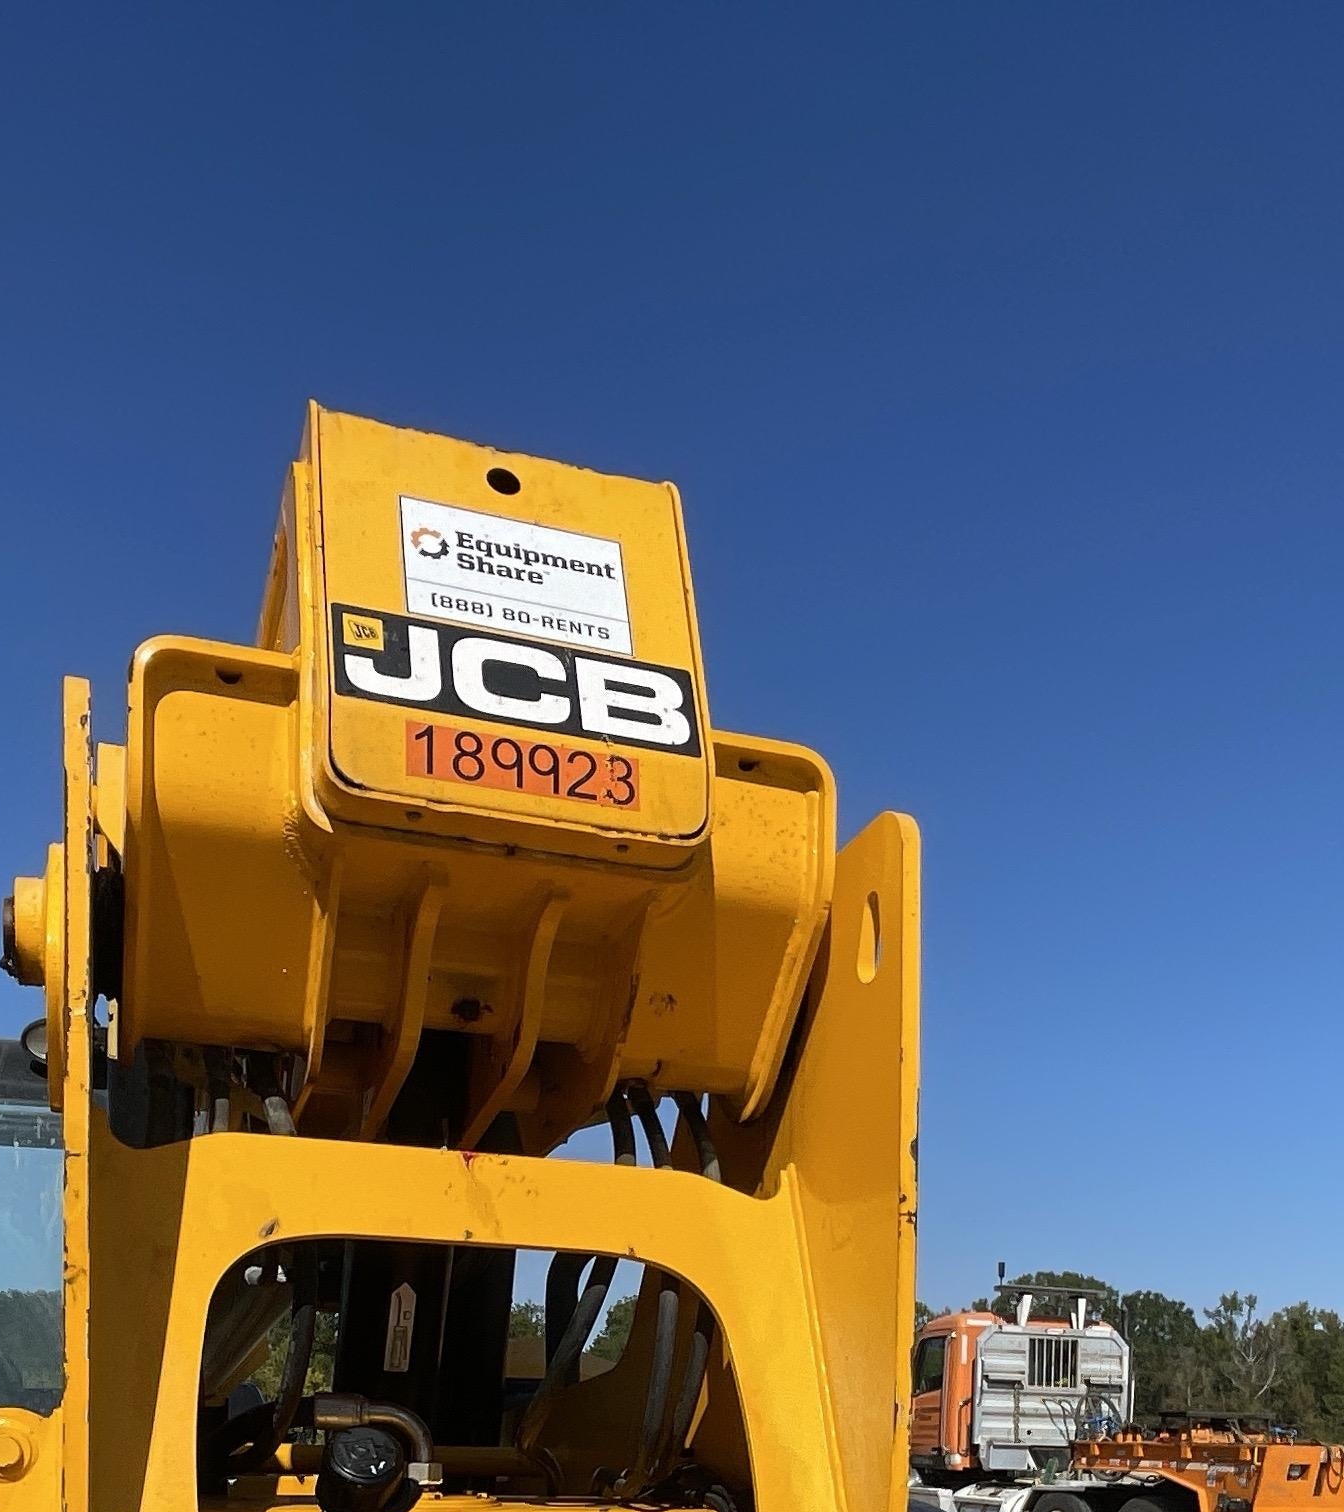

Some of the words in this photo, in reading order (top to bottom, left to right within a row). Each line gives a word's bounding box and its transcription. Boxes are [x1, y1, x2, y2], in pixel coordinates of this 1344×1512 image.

[456, 530, 616, 581] Equipment
[457, 554, 544, 586] Share
[431, 592, 493, 618] (888)
[502, 606, 611, 640] 80-RENTS
[343, 624, 692, 747] JCB
[415, 724, 638, 806] 189923
